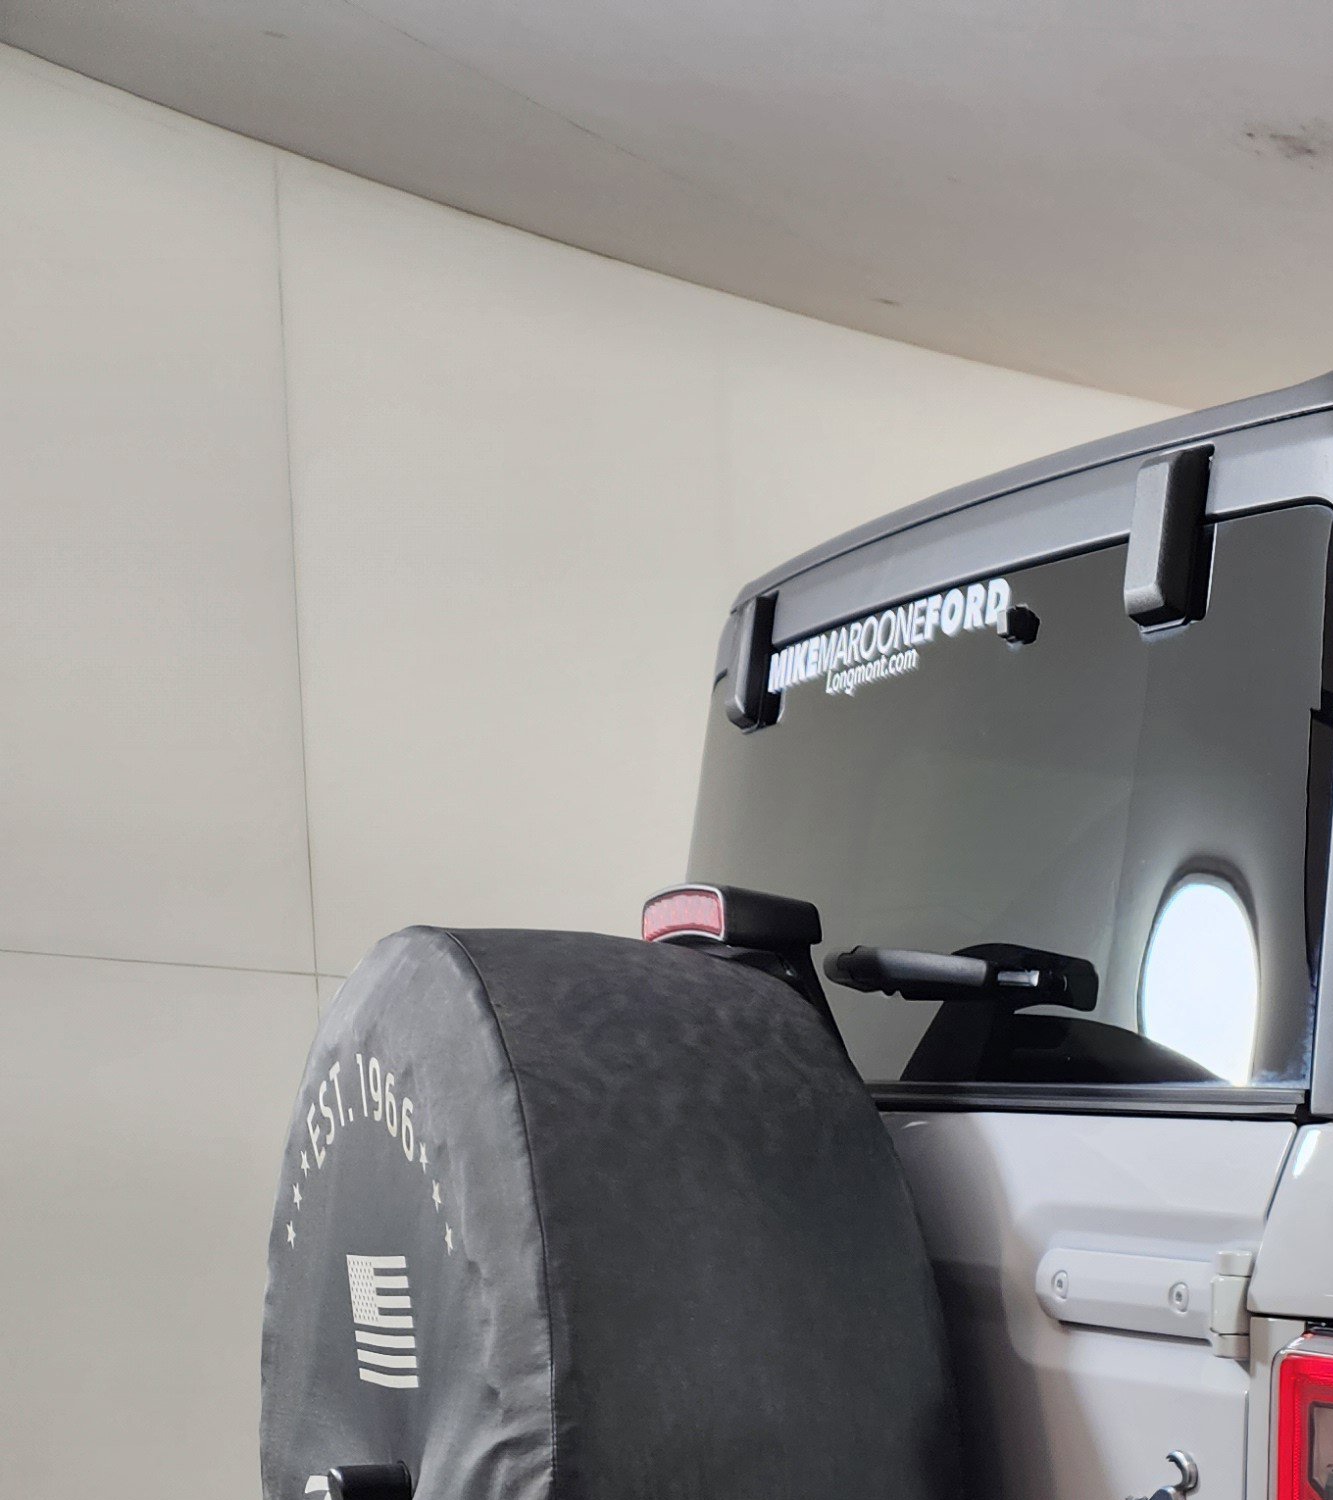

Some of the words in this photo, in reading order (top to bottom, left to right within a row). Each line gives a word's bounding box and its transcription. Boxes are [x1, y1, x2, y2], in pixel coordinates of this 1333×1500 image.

[825, 648, 917, 694] Longmont.com
[307, 1061, 354, 1169] EST.
[355, 1053, 414, 1162] 1966
